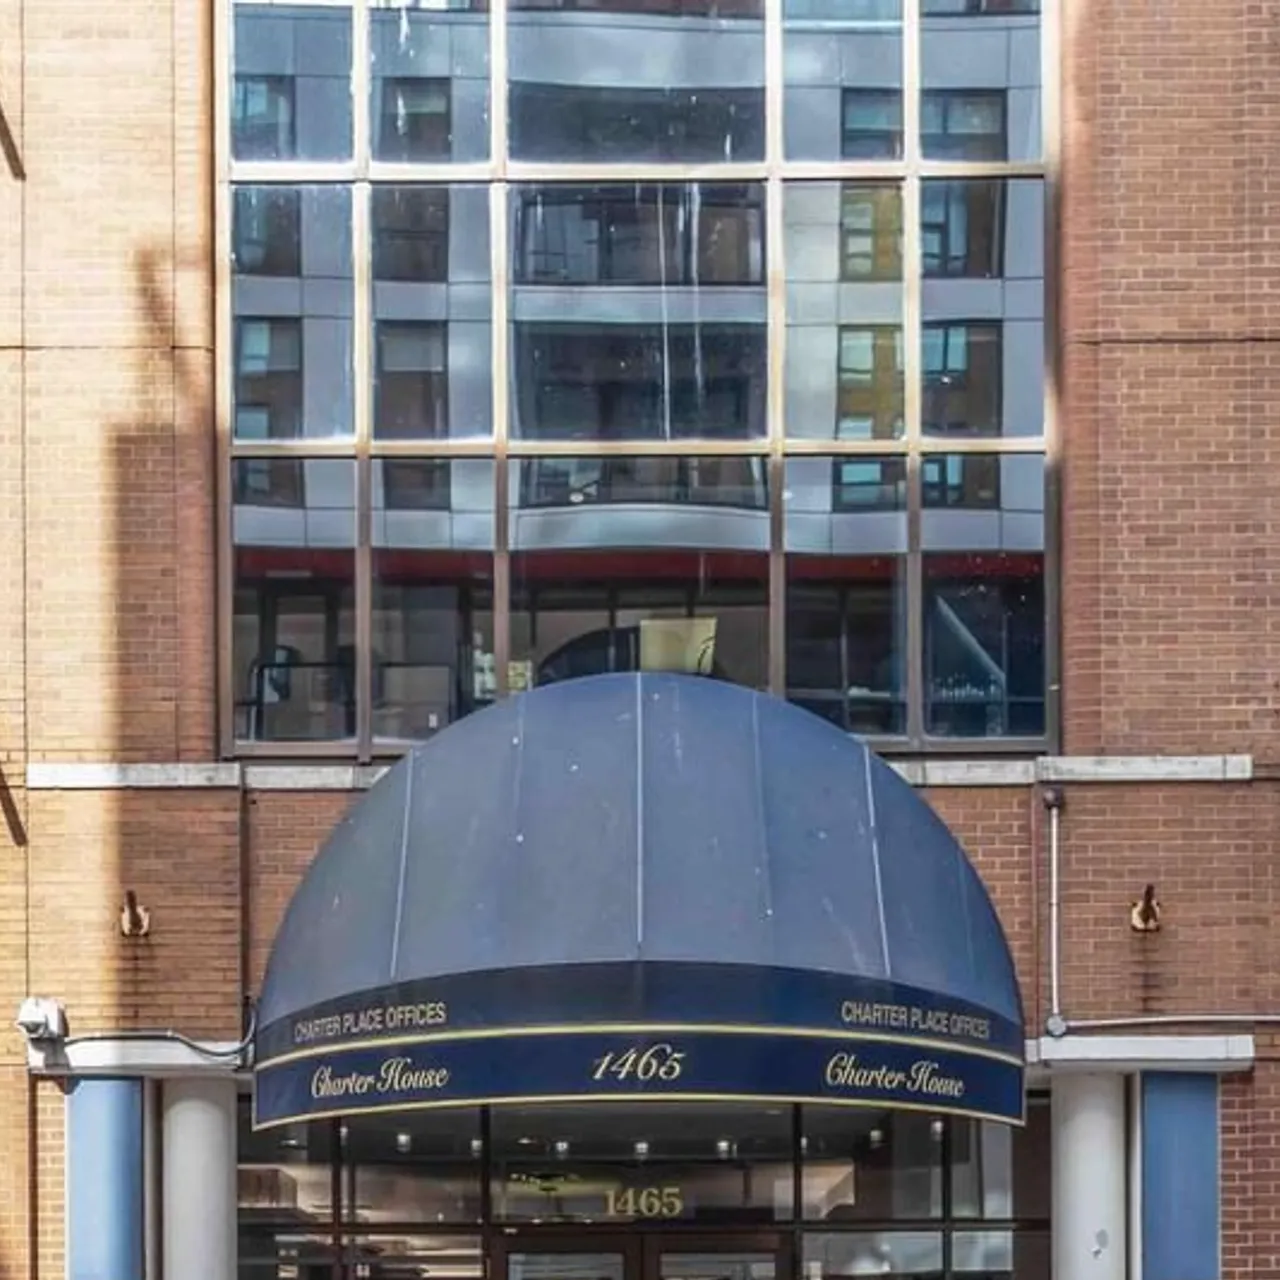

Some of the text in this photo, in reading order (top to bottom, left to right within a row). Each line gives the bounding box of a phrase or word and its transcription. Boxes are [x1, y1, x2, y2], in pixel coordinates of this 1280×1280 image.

[294, 1001, 446, 1043] CHARTER PLACE OFFICES
[841, 1001, 990, 1040] CHARTER PLACE OFFICES
[311, 1056, 448, 1098] Charter House
[593, 1043, 685, 1080] 1465
[826, 1052, 965, 1097] Charter House
[605, 1188, 683, 1217] 1465
